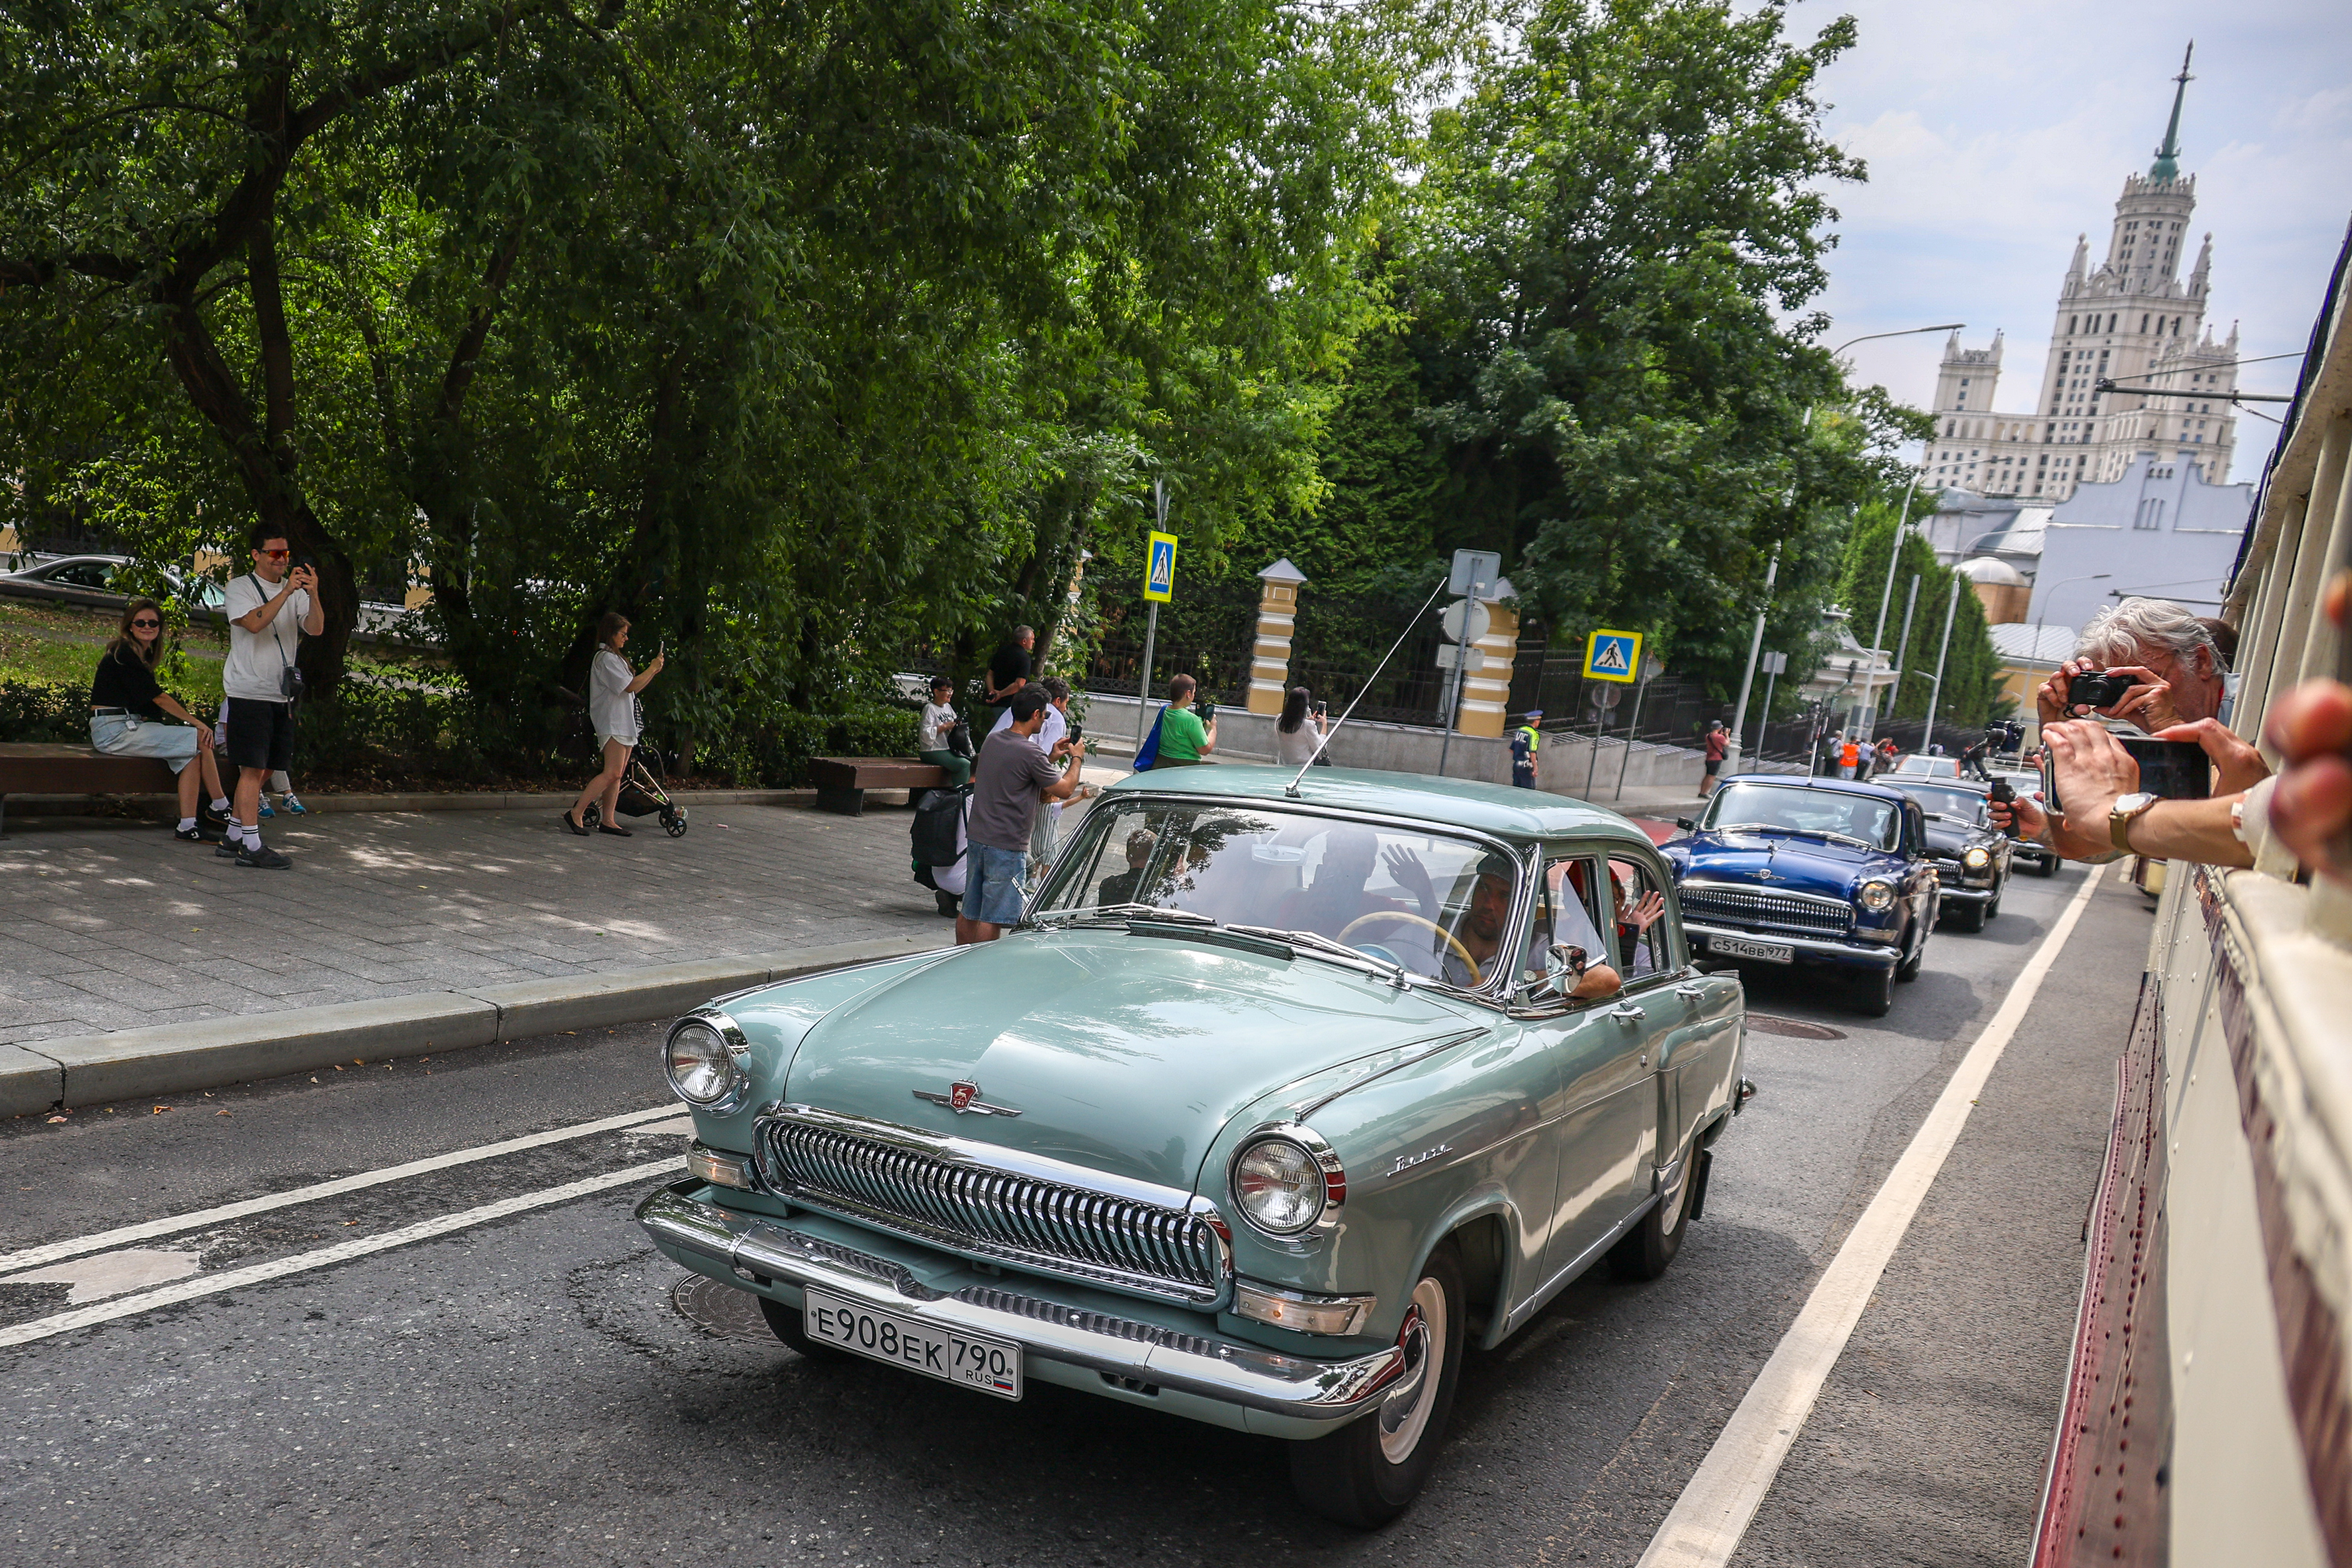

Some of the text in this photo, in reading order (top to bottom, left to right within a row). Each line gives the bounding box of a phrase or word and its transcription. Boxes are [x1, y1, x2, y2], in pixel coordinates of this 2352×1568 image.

[1714, 941, 1788, 957] С514ВВ 977
[817, 1306, 1006, 1376] Е908ЕК 790
[965, 1369, 993, 1385] RUS
